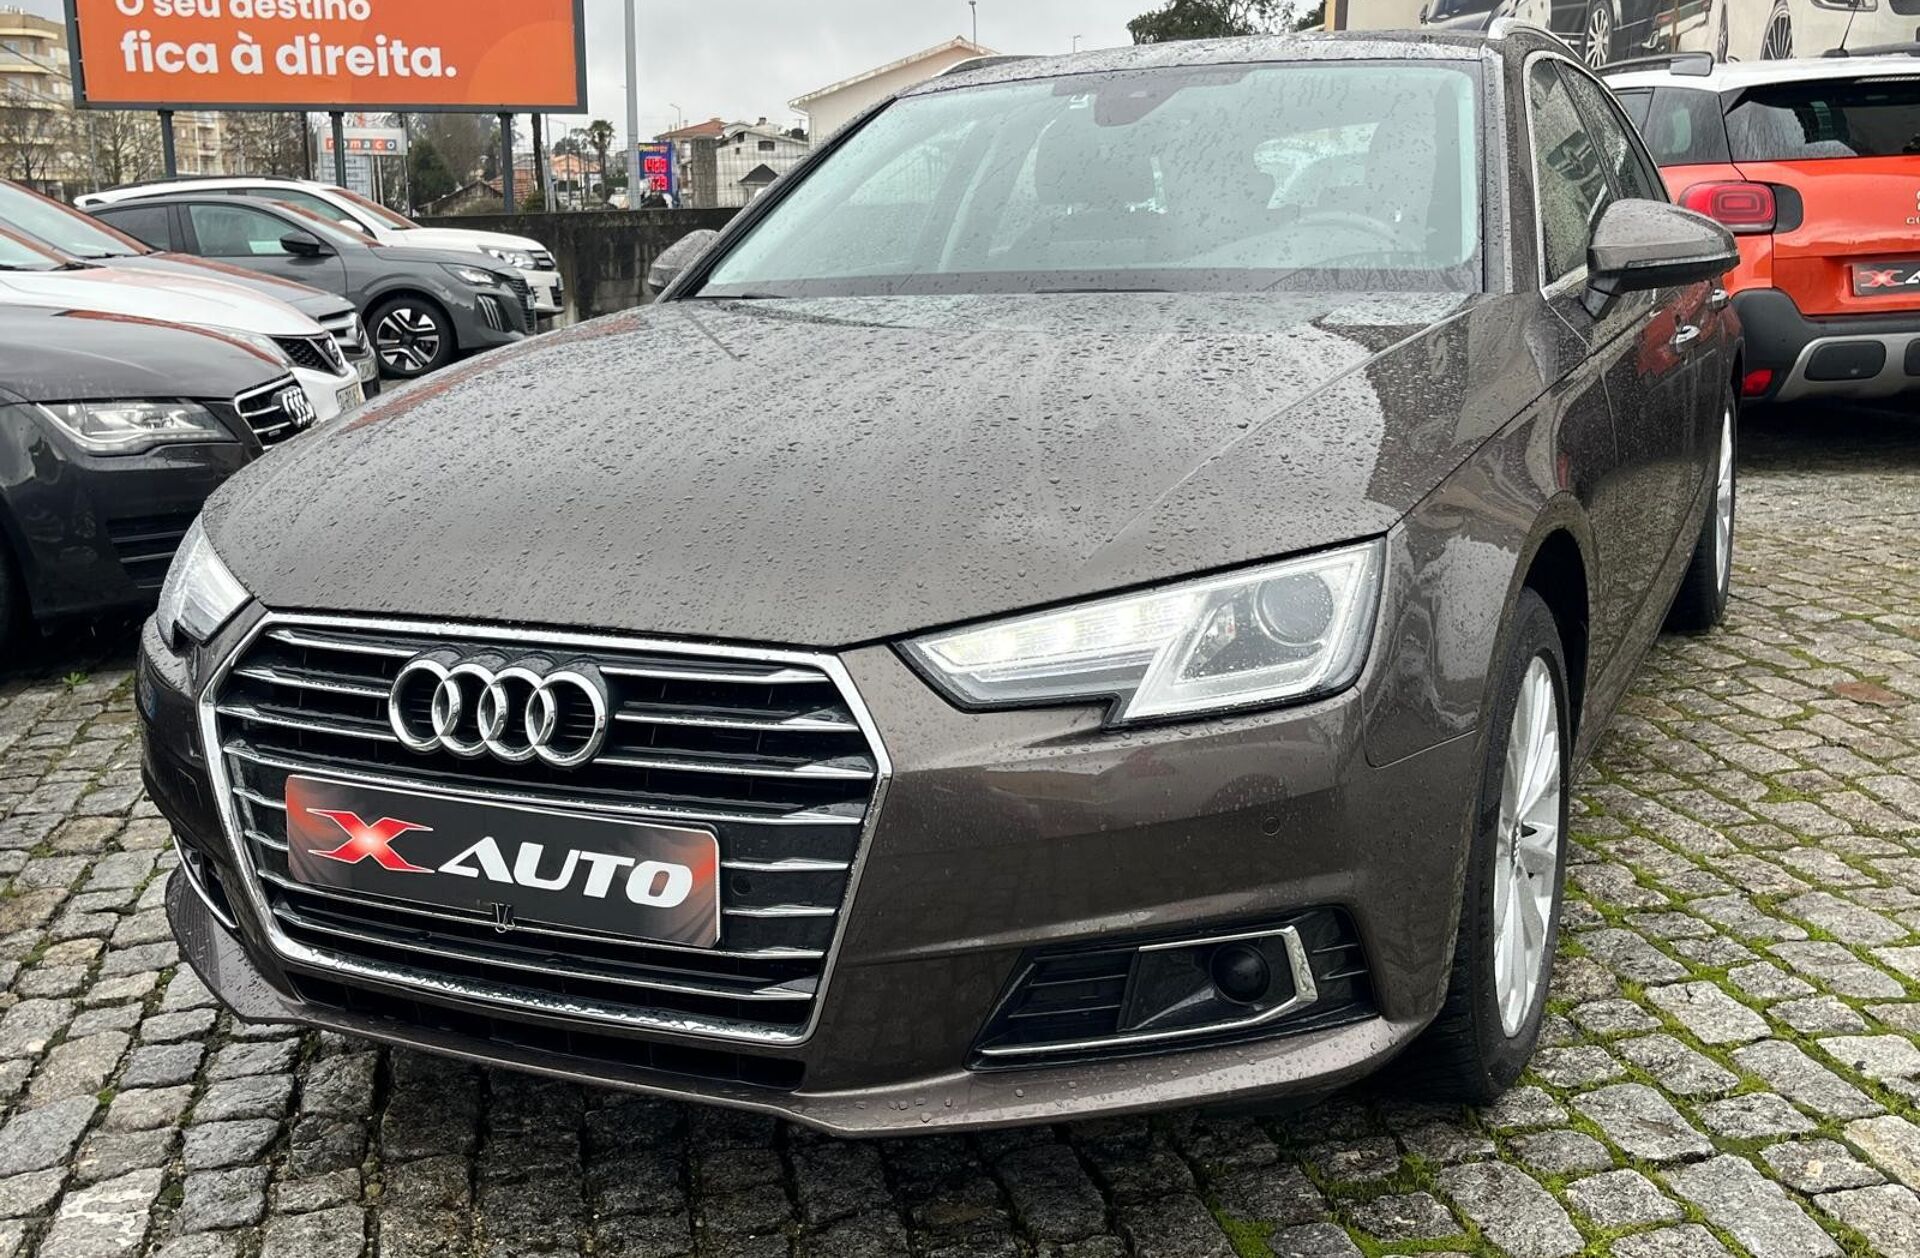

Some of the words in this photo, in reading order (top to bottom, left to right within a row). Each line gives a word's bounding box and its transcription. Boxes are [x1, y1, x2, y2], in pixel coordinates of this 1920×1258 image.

[120, 29, 219, 73] fica
[230, 30, 264, 74] à
[275, 32, 457, 77] direita.
[306, 807, 435, 874] X
[437, 836, 694, 908] AUTO
